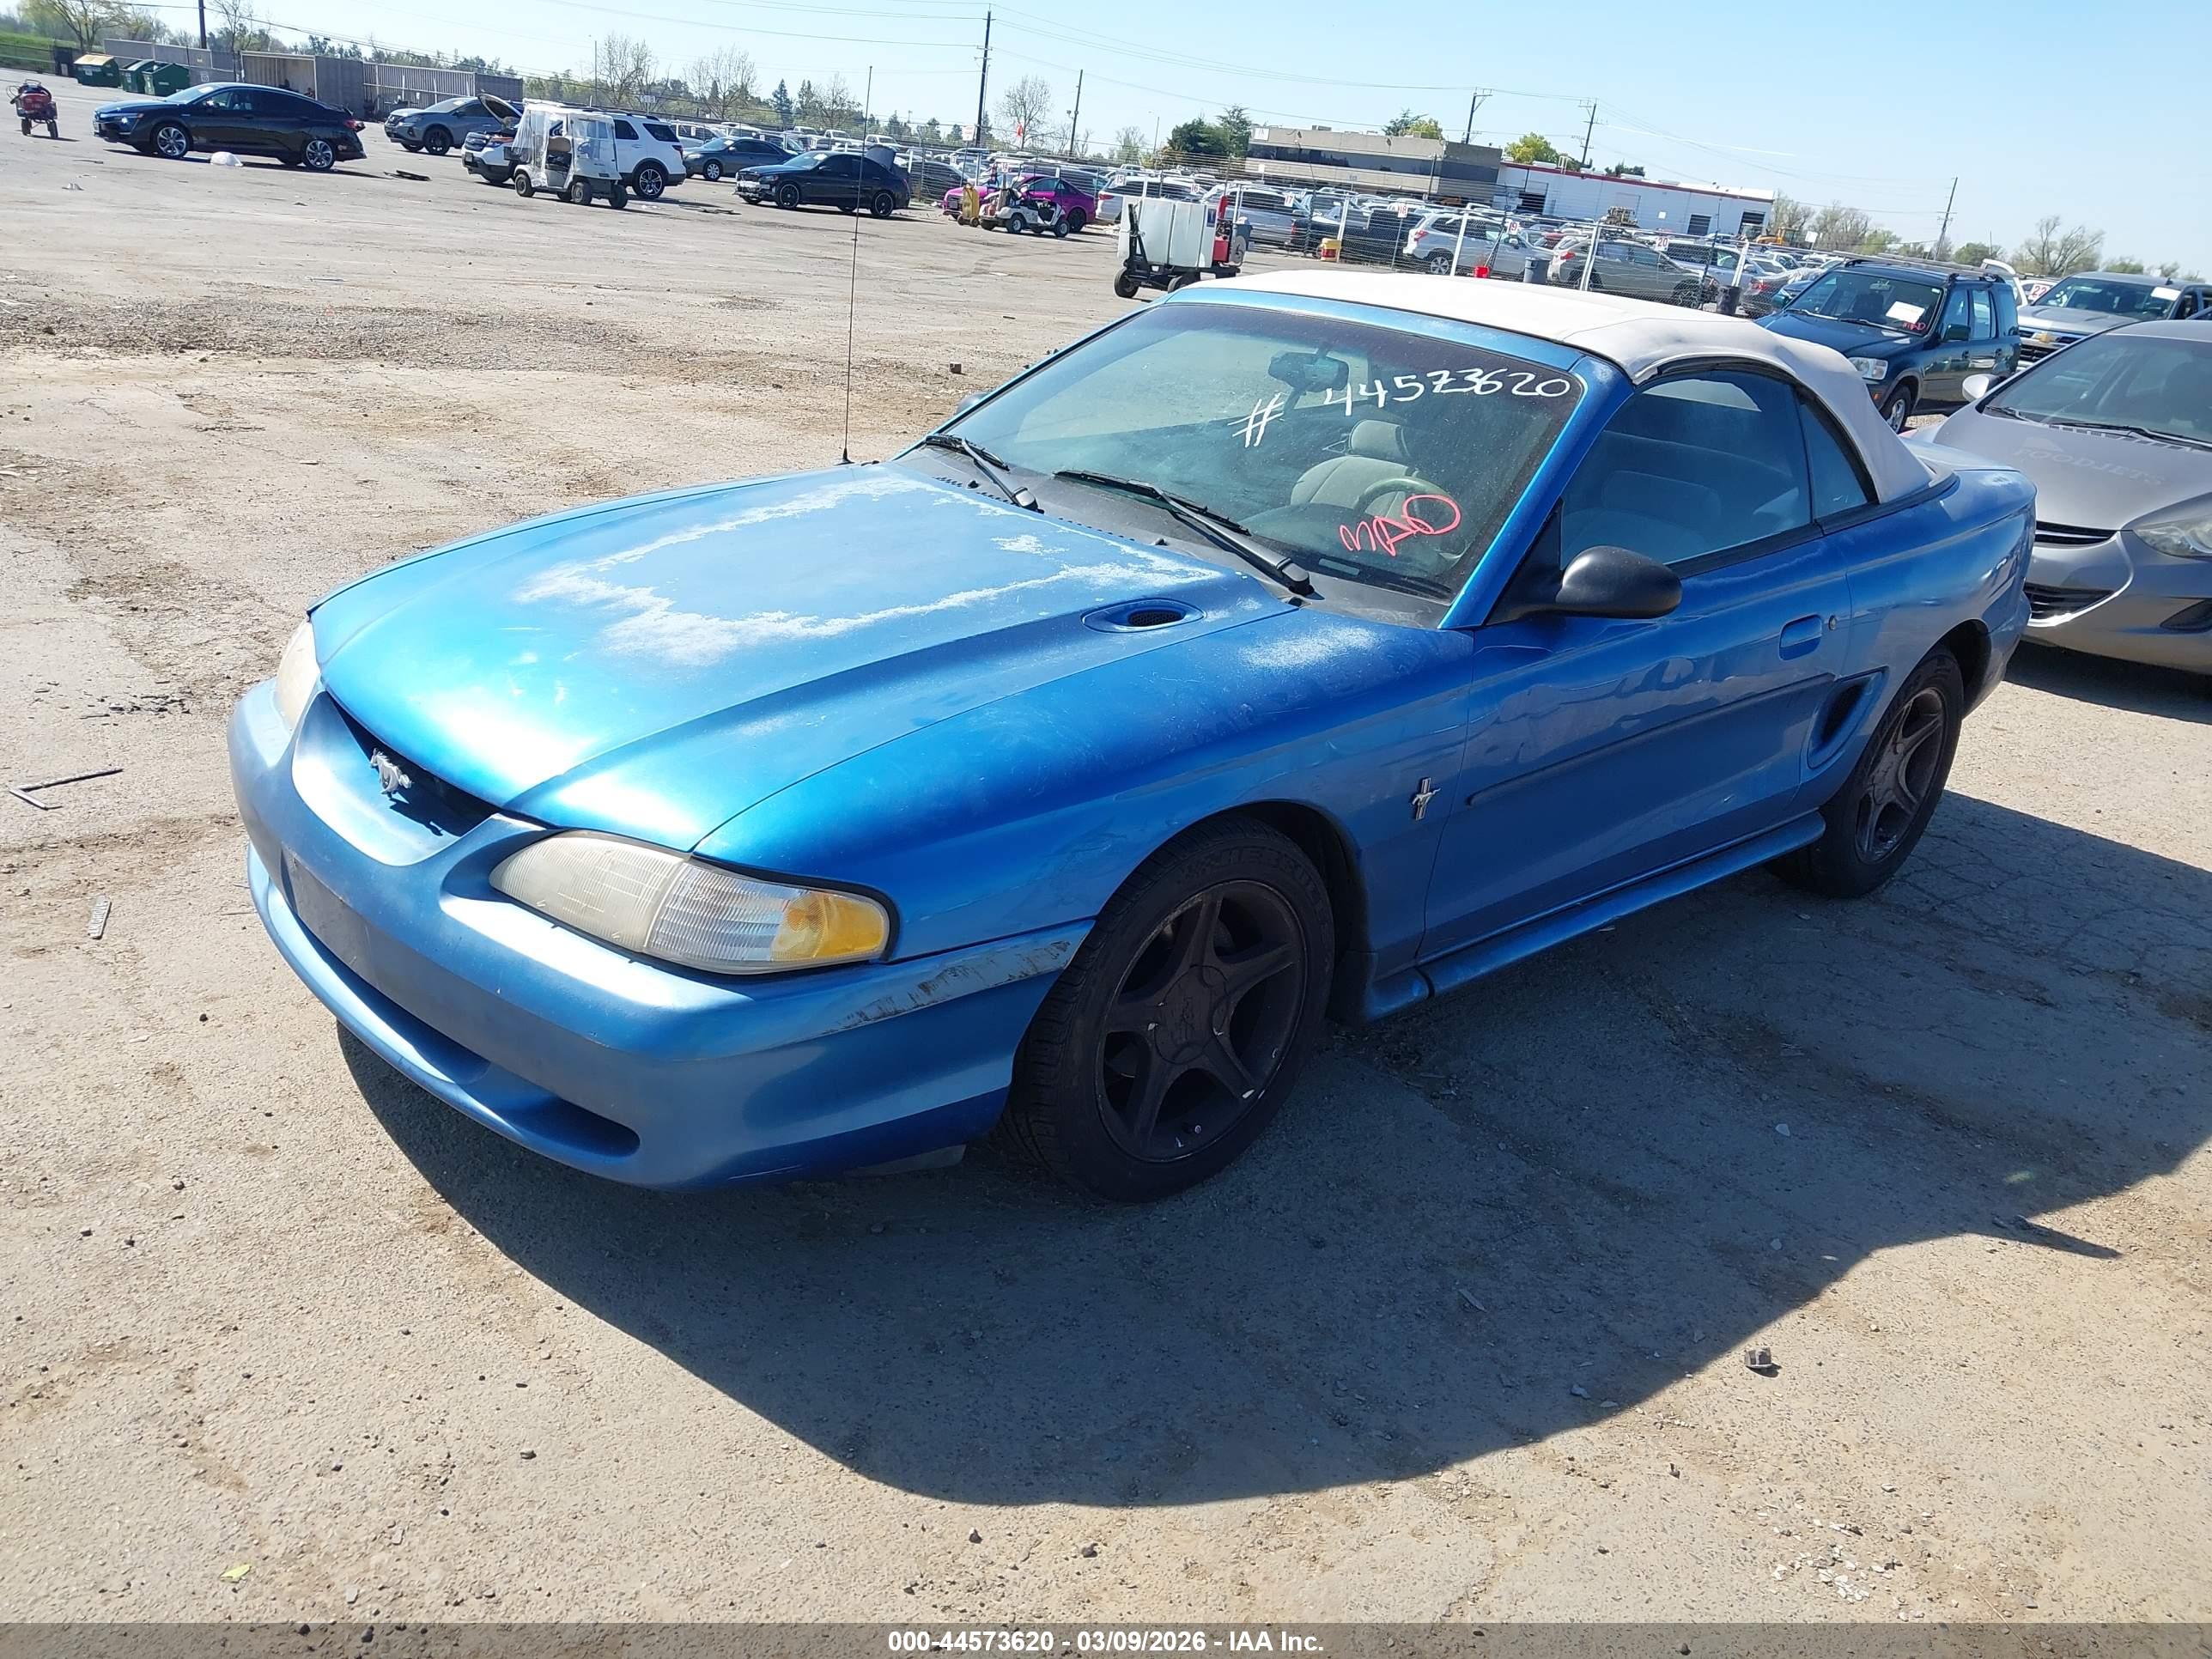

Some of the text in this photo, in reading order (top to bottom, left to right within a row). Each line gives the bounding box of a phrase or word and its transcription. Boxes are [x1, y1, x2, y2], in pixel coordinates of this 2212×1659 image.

[1657, 237, 1668, 247] 20
[2032, 285, 2047, 296] 22
[1322, 368, 1571, 416] 44573620
